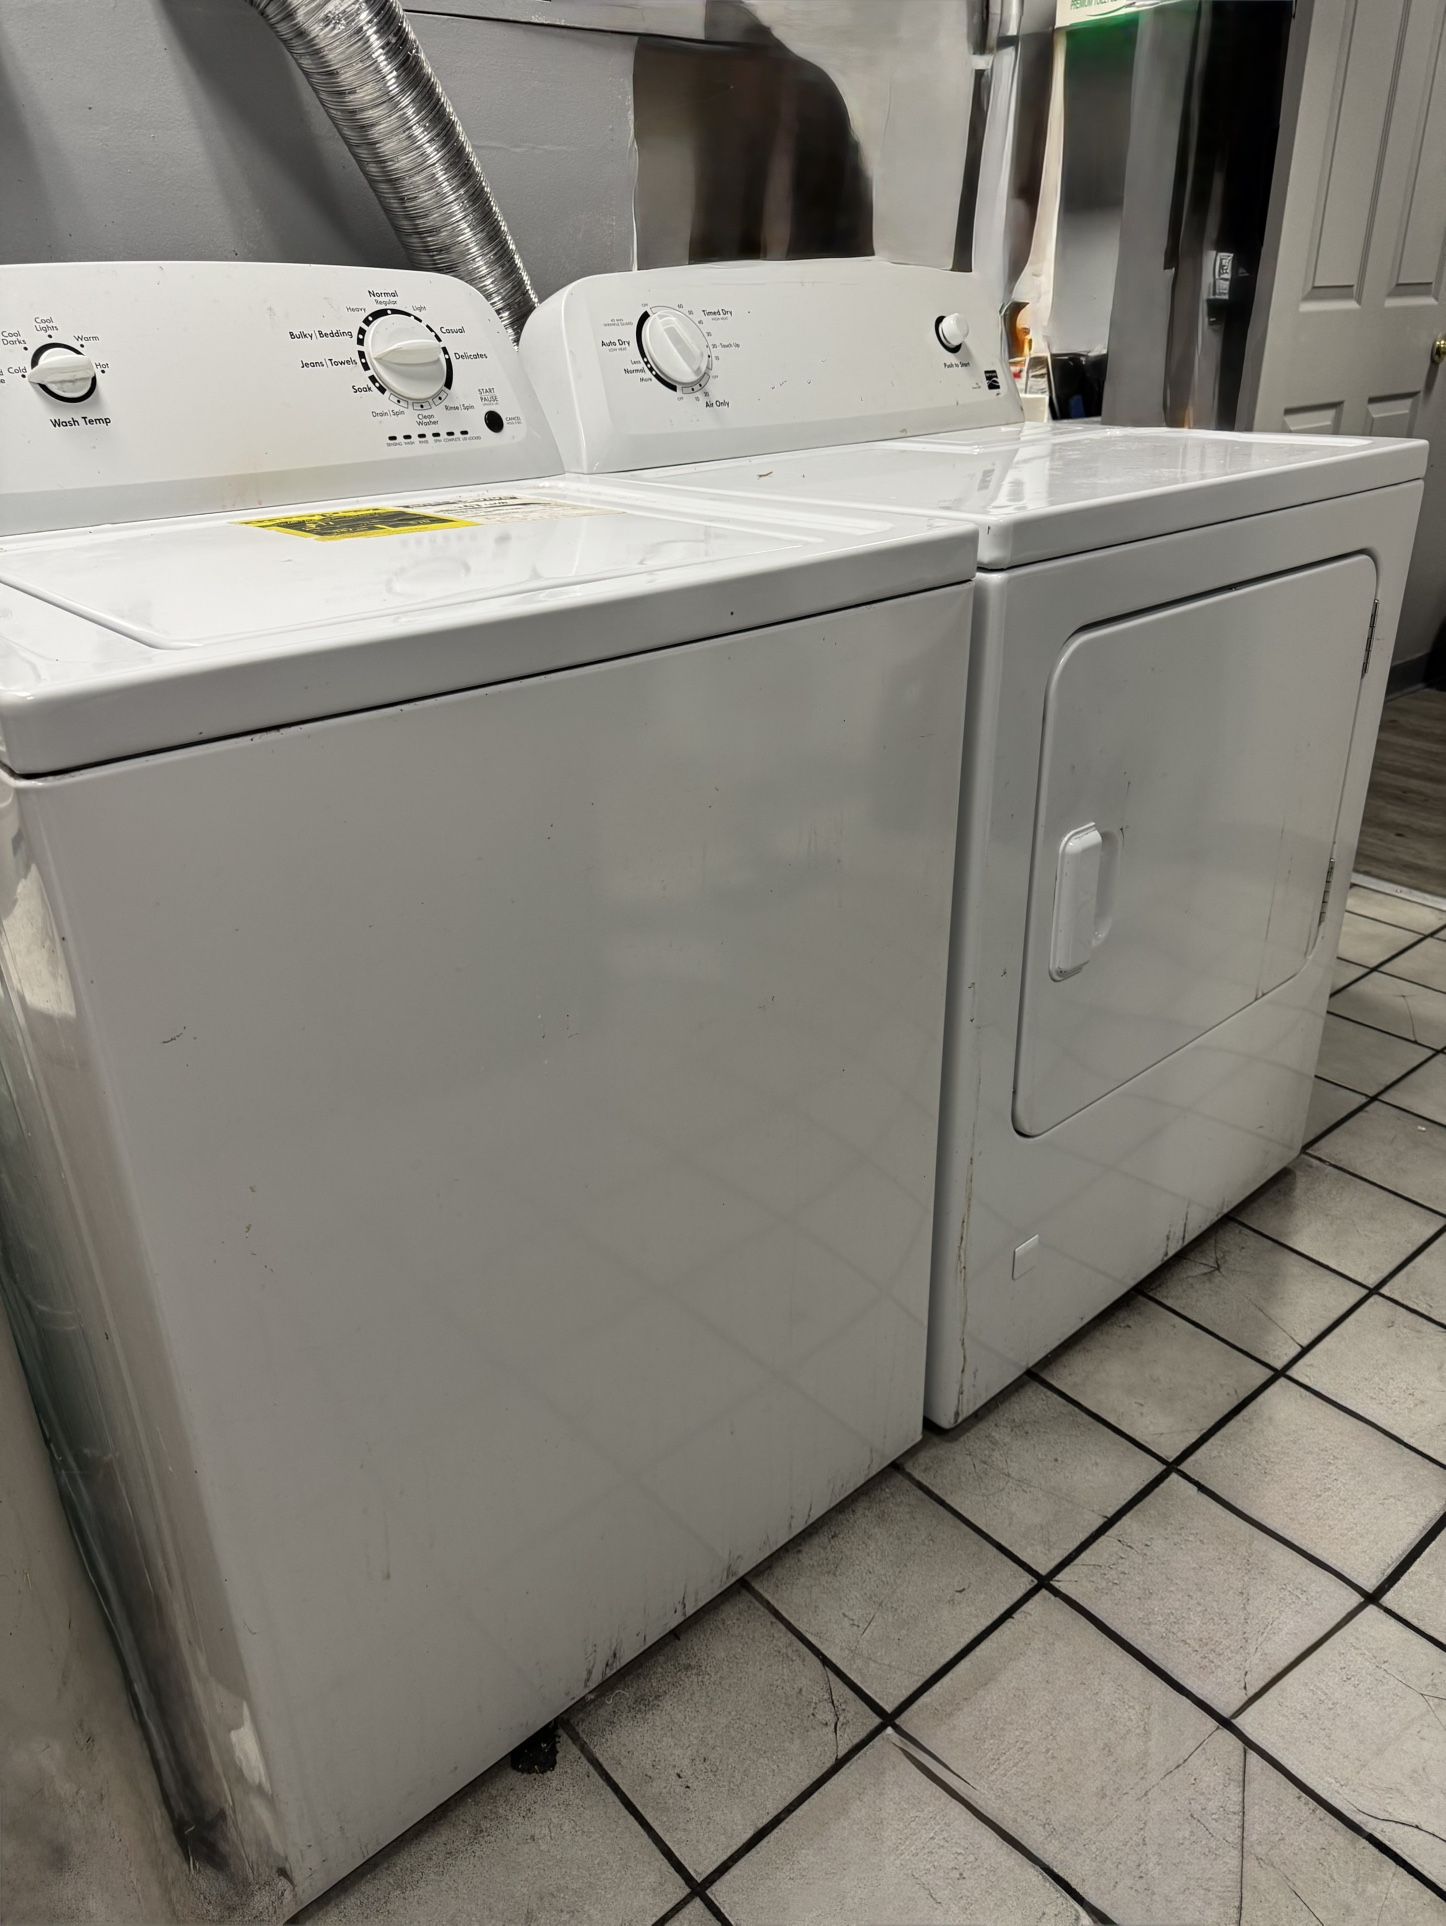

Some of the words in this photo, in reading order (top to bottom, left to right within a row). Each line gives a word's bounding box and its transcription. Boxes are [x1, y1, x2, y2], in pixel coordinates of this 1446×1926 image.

[722, 308, 732, 316] Dry
[34, 324, 58, 333] Lights
[289, 332, 314, 340] Bulky
[318, 330, 354, 338] Bedding
[617, 339, 630, 347] Dry
[300, 360, 324, 368] Jeans
[328, 357, 357, 366] Towels
[7, 366, 27, 374] Cold
[352, 384, 373, 393] Soak
[715, 400, 729, 408] Only
[50, 417, 80, 428] Wash
[81, 416, 111, 426] Temp
